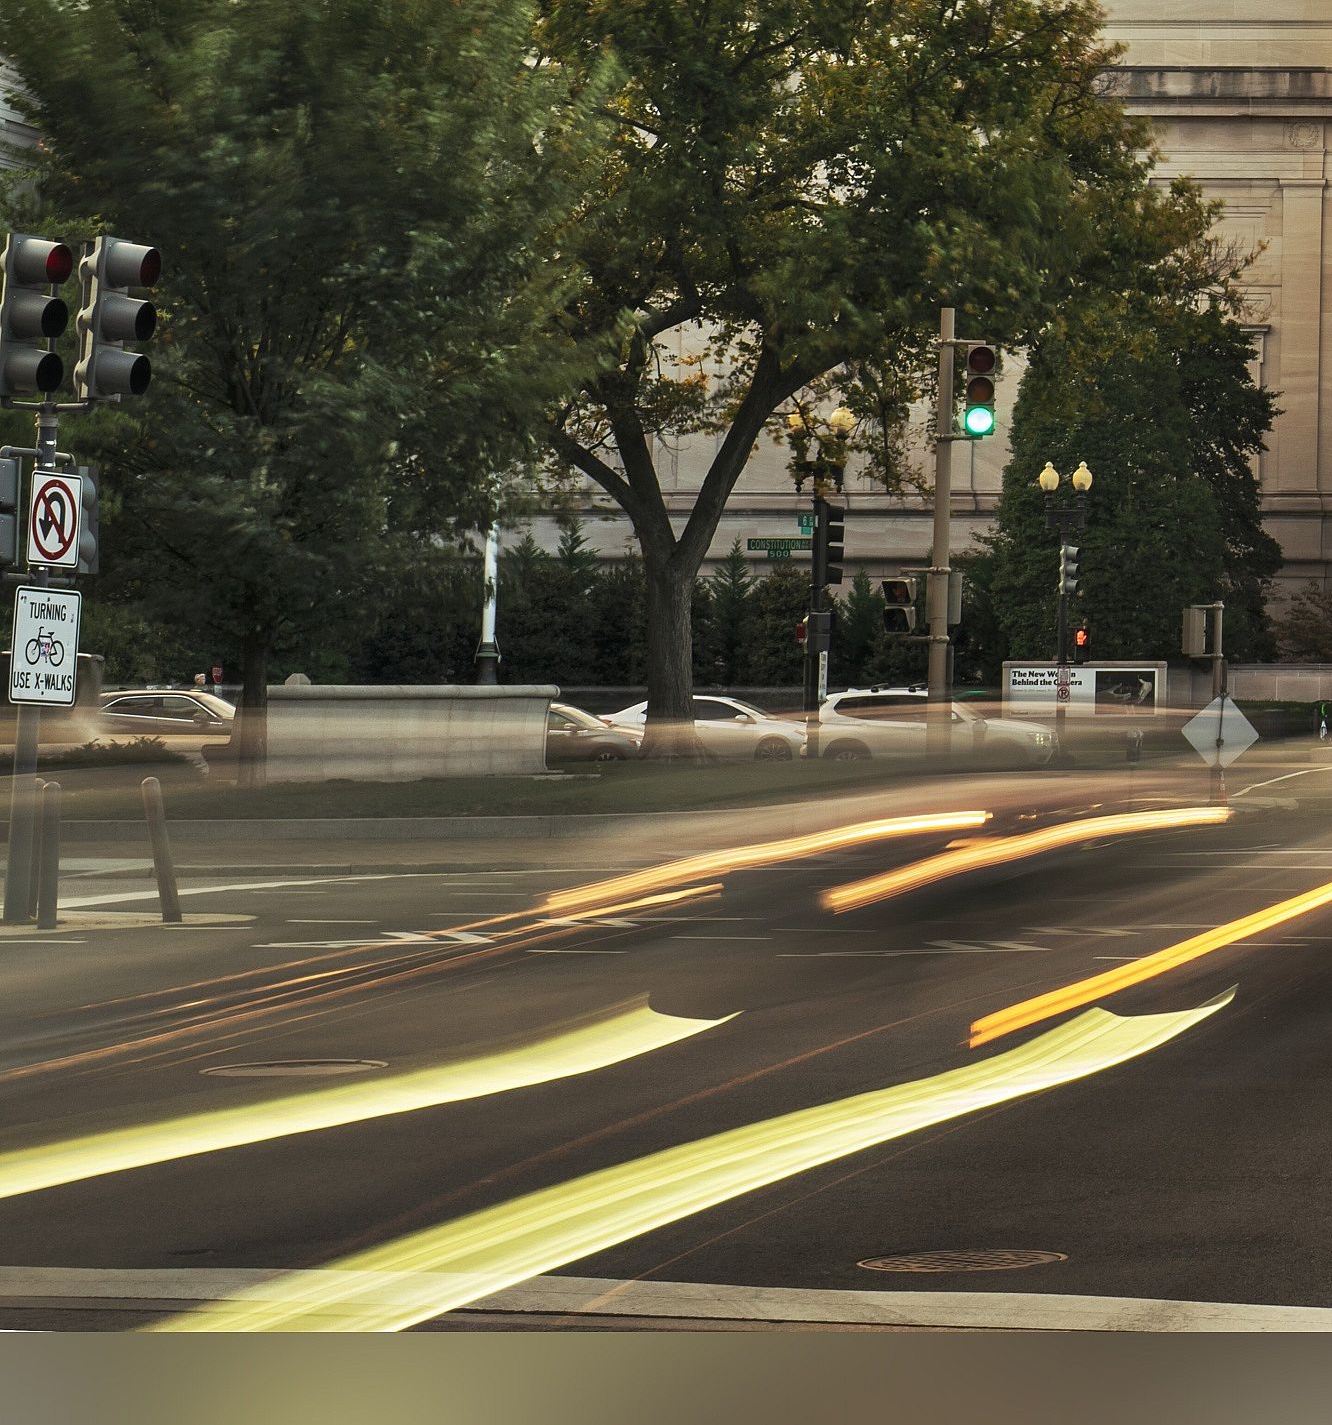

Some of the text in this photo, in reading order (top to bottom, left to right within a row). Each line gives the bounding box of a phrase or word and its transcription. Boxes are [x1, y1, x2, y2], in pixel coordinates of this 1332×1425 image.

[750, 539, 800, 550] CONSTITUTION
[769, 550, 789, 558] 500
[29, 602, 67, 621] TURNING
[1012, 670, 1027, 678] The
[1028, 670, 1046, 678] New
[1047, 670, 1076, 678] Won
[13, 671, 73, 692] USE X-WALKS
[1012, 678, 1039, 686] Behind
[1040, 678, 1053, 686] the
[1054, 678, 1083, 686] Cera
